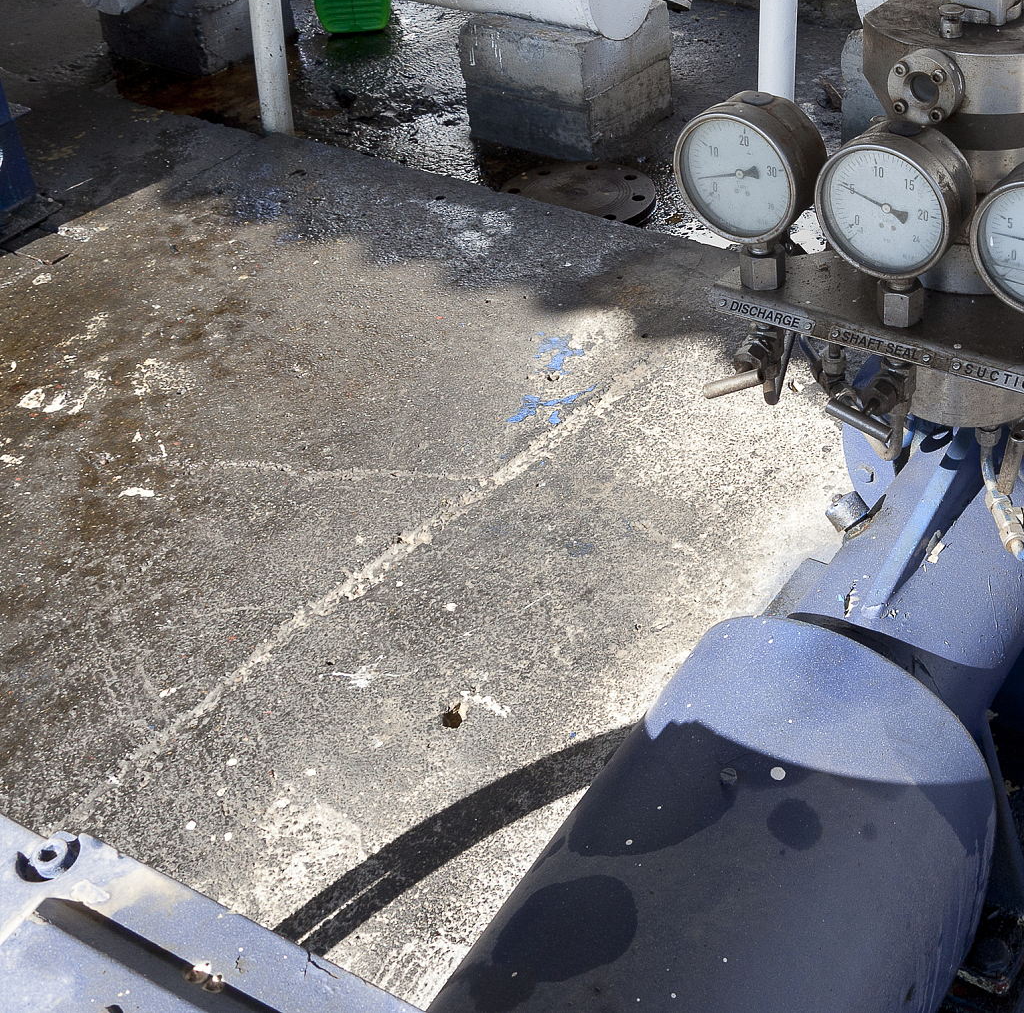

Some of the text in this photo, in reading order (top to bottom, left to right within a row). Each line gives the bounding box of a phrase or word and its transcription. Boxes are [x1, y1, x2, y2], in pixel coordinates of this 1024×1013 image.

[739, 135, 749, 147] 20
[709, 146, 718, 157] 10
[767, 166, 776, 177] 30
[874, 166, 883, 178] 10
[712, 182, 718, 192] 0
[850, 184, 855, 195] 5
[904, 179, 914, 191] 15
[855, 215, 859, 225] 0
[918, 209, 928, 221] 20
[1007, 218, 1013, 229] 5
[1012, 250, 1016, 261] 0
[730, 301, 800, 328] DISCHARGE
[841, 332, 919, 360] SHAFT SEAL
